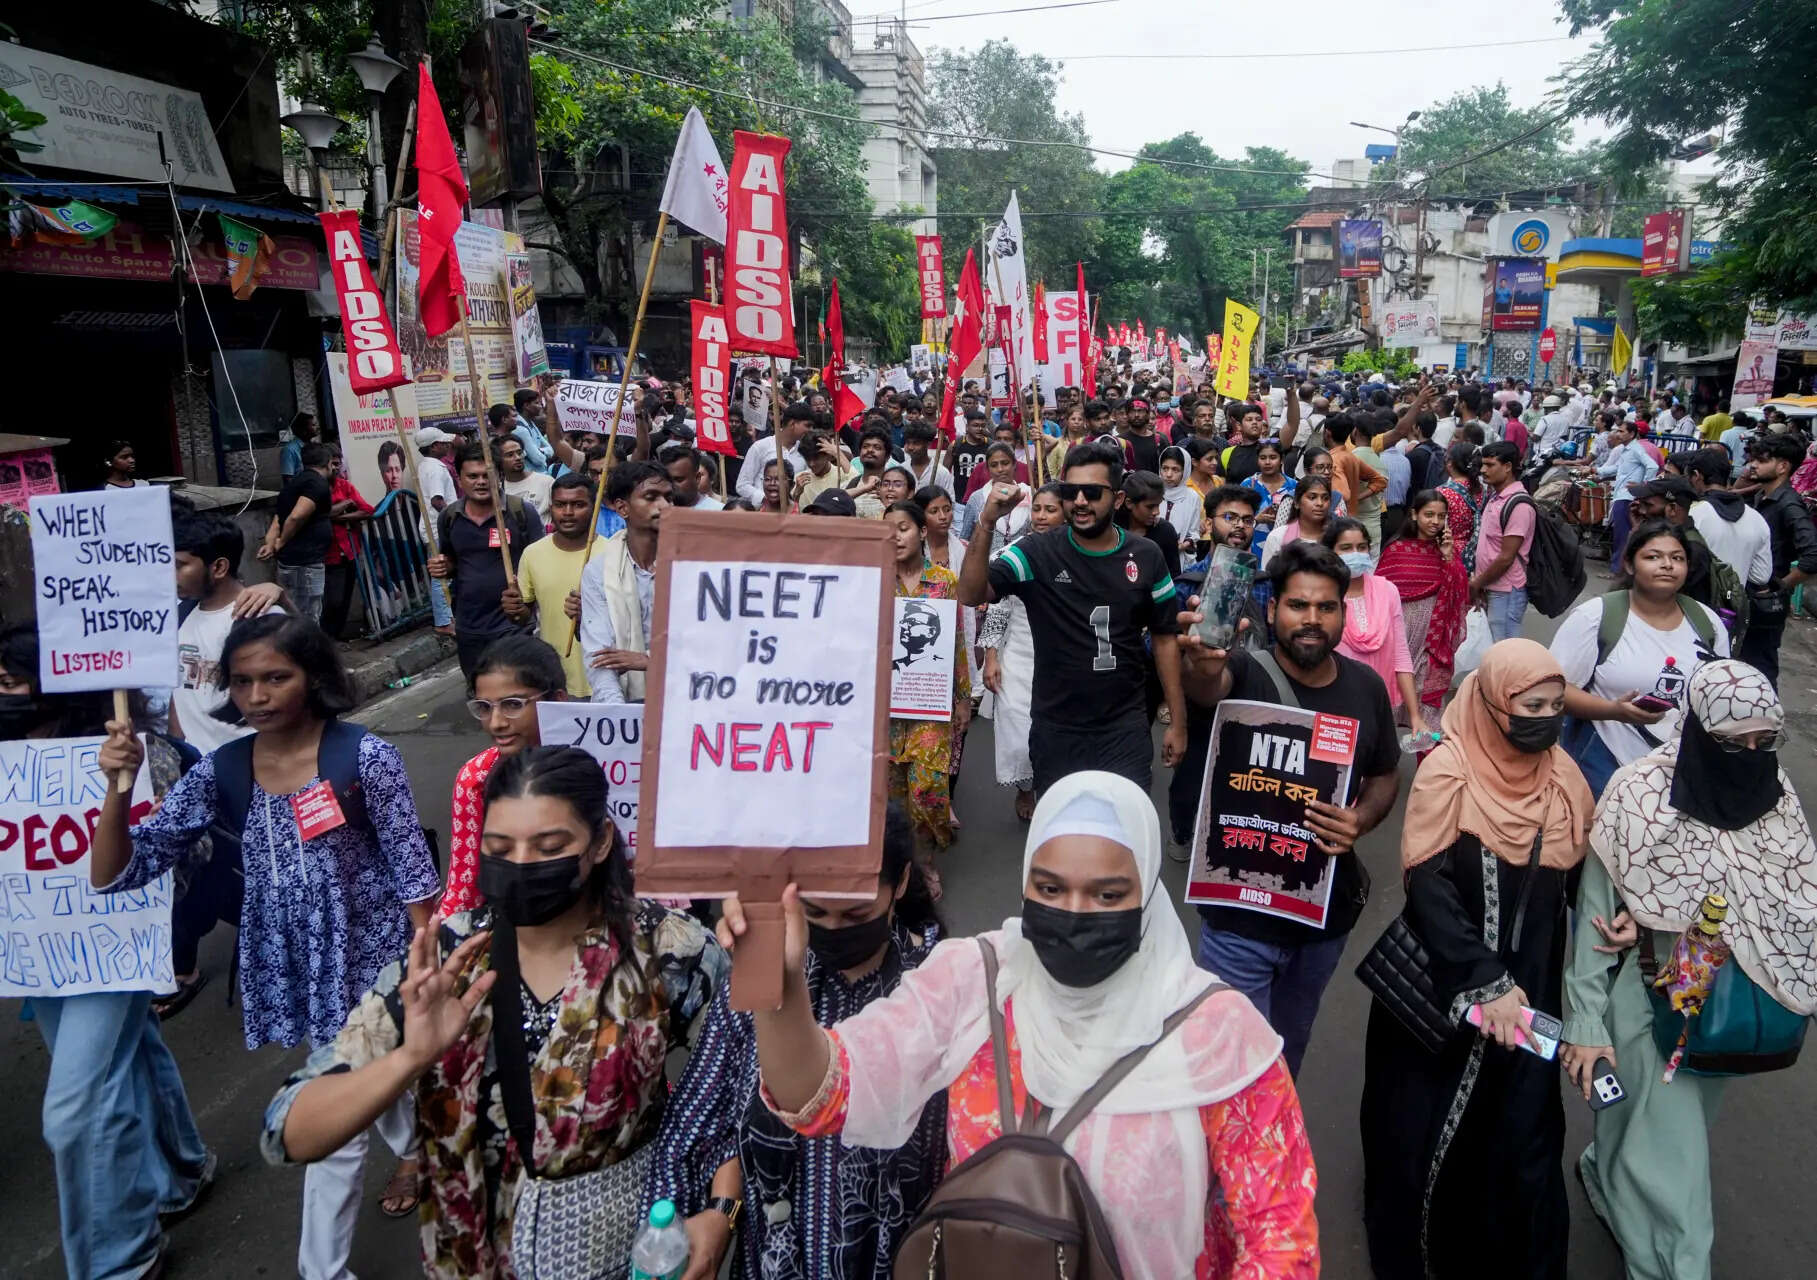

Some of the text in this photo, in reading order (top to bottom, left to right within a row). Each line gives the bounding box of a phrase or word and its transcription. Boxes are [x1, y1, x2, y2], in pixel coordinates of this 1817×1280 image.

[29, 65, 163, 124] BEDROCK
[59, 105, 87, 120] AUTO
[59, 251, 104, 264] Auto
[111, 255, 163, 268] Spare
[735, 153, 784, 342] AIDSO
[469, 281, 500, 298] KOLKATA
[920, 242, 945, 312] AIDSO
[335, 230, 394, 379] AIDSO
[1054, 297, 1079, 387] SFI
[560, 383, 600, 402] রাজা
[697, 316, 729, 442] AIDSO
[348, 419, 371, 434] IMRAN
[37, 503, 107, 539] WHEN
[75, 539, 172, 566] STUDENTS
[697, 568, 839, 622] NEET
[81, 607, 170, 638] HISTORY
[1089, 605, 1118, 671] 1
[746, 629, 779, 665] is
[688, 671, 737, 702] no
[755, 676, 856, 707] more
[689, 721, 834, 774] NEAT
[1249, 732, 1306, 777] NTA
[1228, 768, 1320, 807] বাতিল কর
[1222, 827, 1310, 863] রক্ষা কর
[1239, 887, 1273, 907] AIDSO
[39, 930, 91, 988] IN
